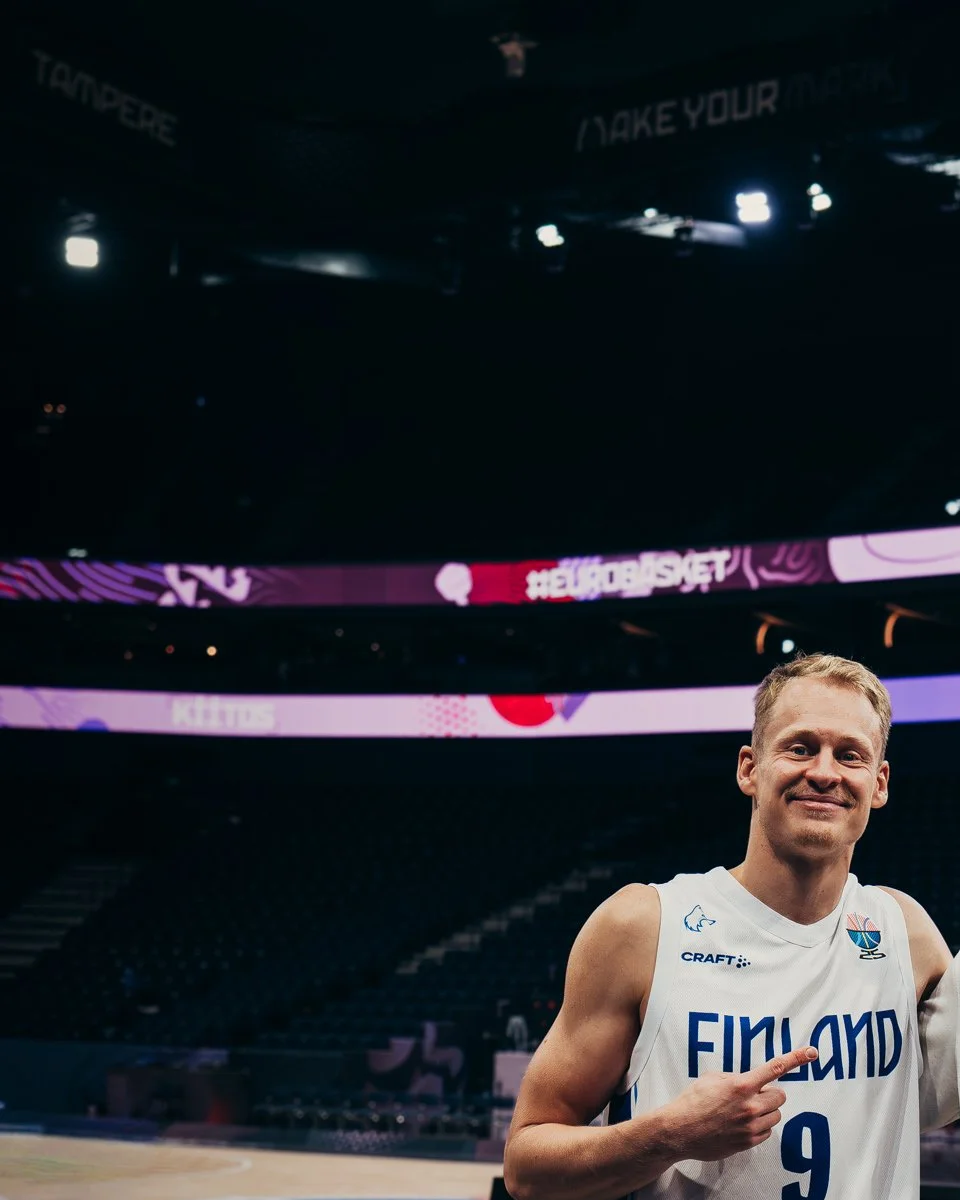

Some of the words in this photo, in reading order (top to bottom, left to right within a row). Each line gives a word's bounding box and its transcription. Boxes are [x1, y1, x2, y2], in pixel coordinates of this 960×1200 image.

[30, 48, 178, 148] TAMPERE
[683, 76, 783, 131] YOUR
[526, 550, 732, 600] #EUROBASKET
[681, 951, 737, 966] CRAFT
[688, 1008, 903, 1082] FINLAND
